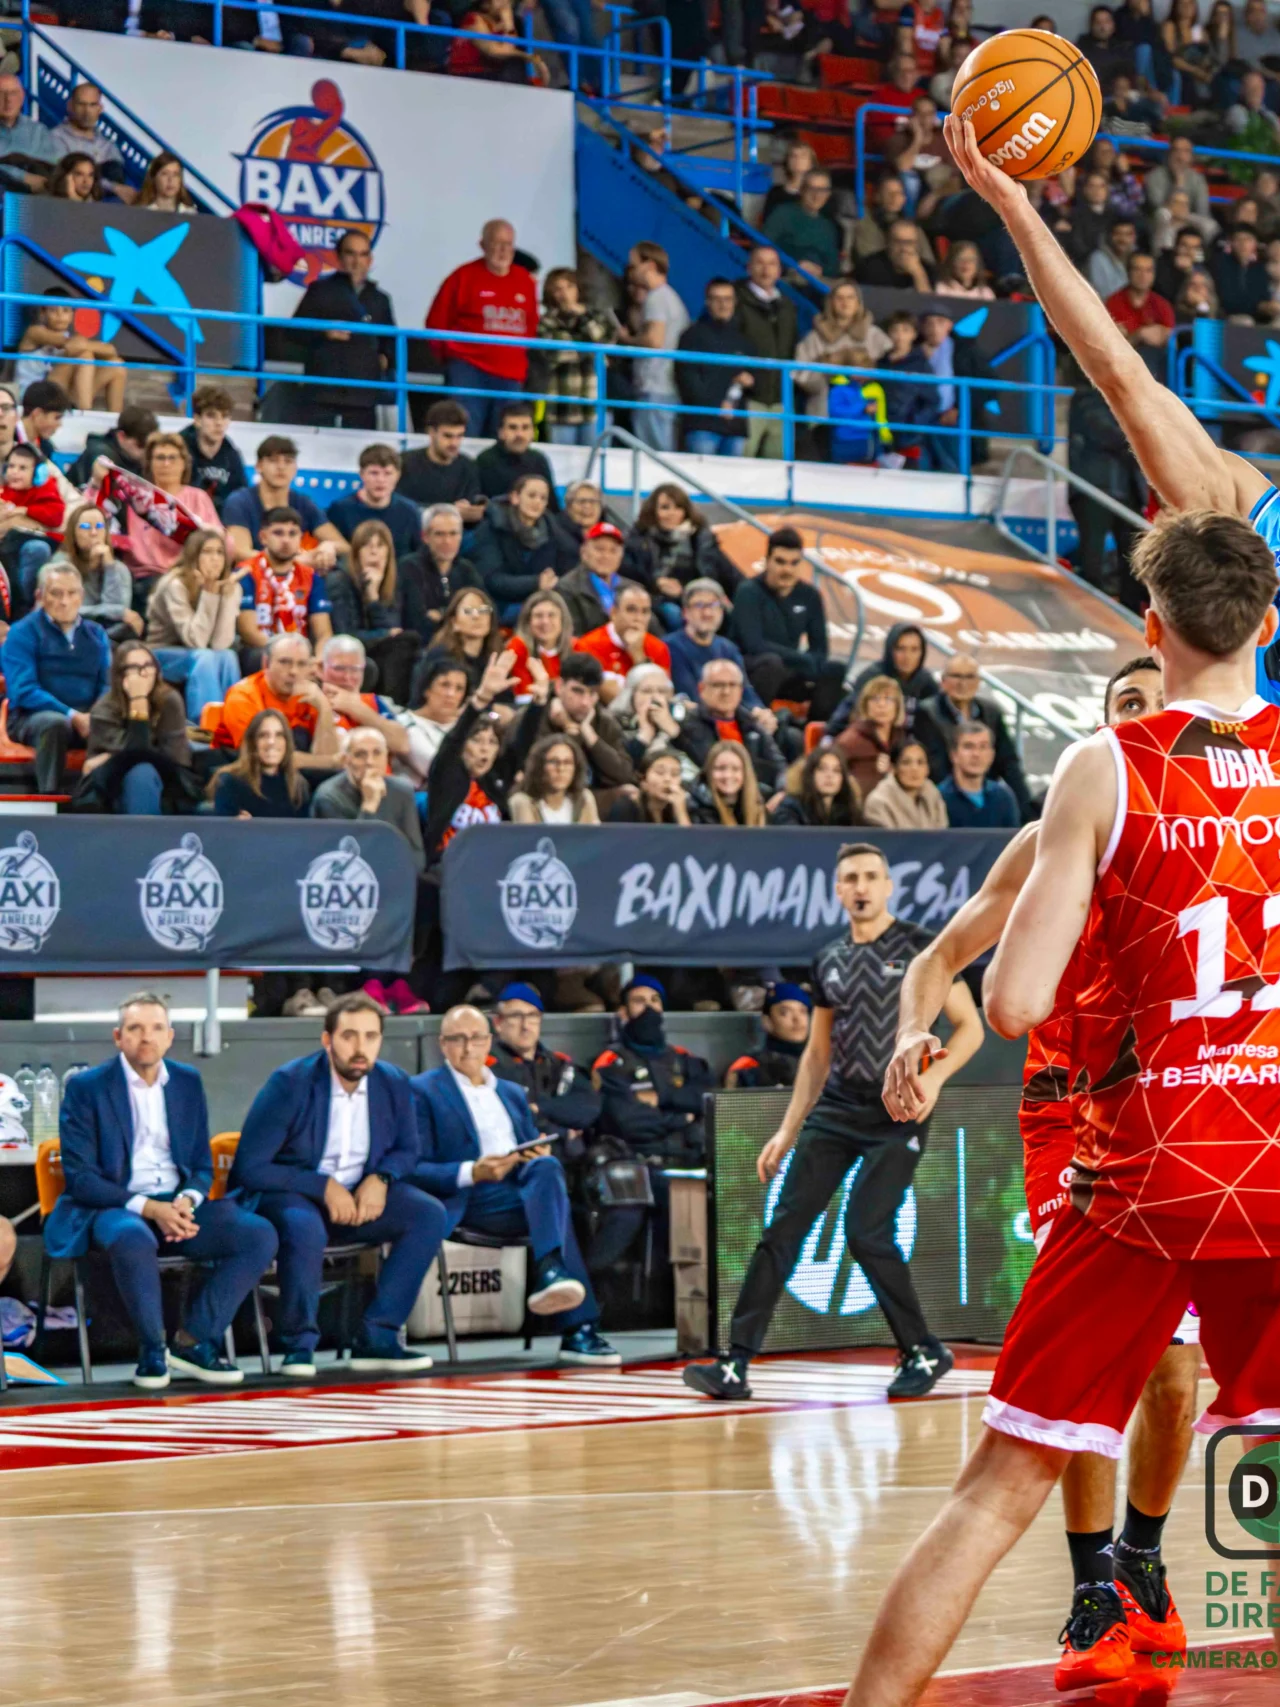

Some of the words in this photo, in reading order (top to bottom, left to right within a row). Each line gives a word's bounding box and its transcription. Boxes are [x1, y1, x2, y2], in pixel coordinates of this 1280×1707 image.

[987, 112, 1058, 167] Wilso
[245, 159, 380, 220] BAXI
[0, 881, 56, 908] AXI
[146, 882, 220, 909] BAXI
[305, 883, 375, 909] BAXI
[506, 883, 573, 909] BAXI
[615, 844, 975, 933] BAXIMANESA
[1197, 1043, 1279, 1061] Manresa
